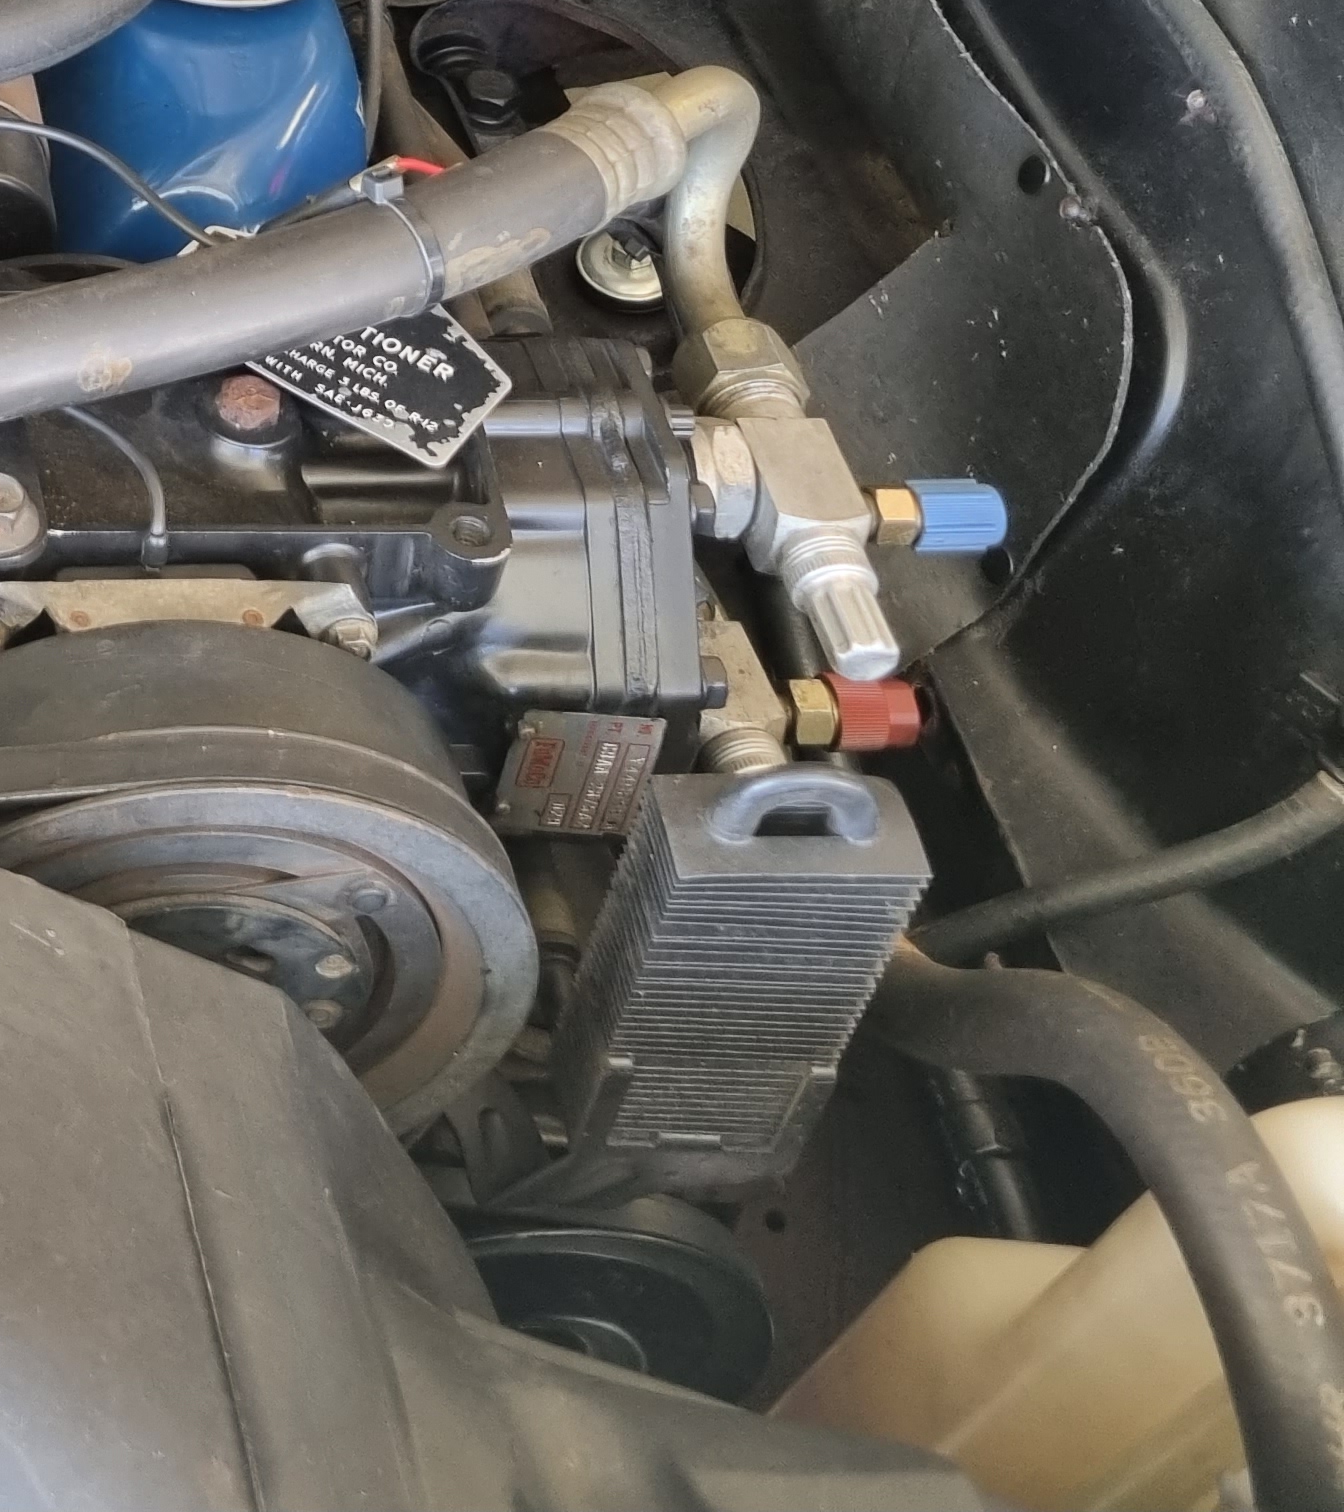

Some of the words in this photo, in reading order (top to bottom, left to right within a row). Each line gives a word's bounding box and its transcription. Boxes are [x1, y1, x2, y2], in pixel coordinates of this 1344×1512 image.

[265, 354, 302, 382] WITH
[286, 348, 336, 380] HARGE
[359, 327, 456, 382] TIONER
[342, 356, 389, 388] MICH.
